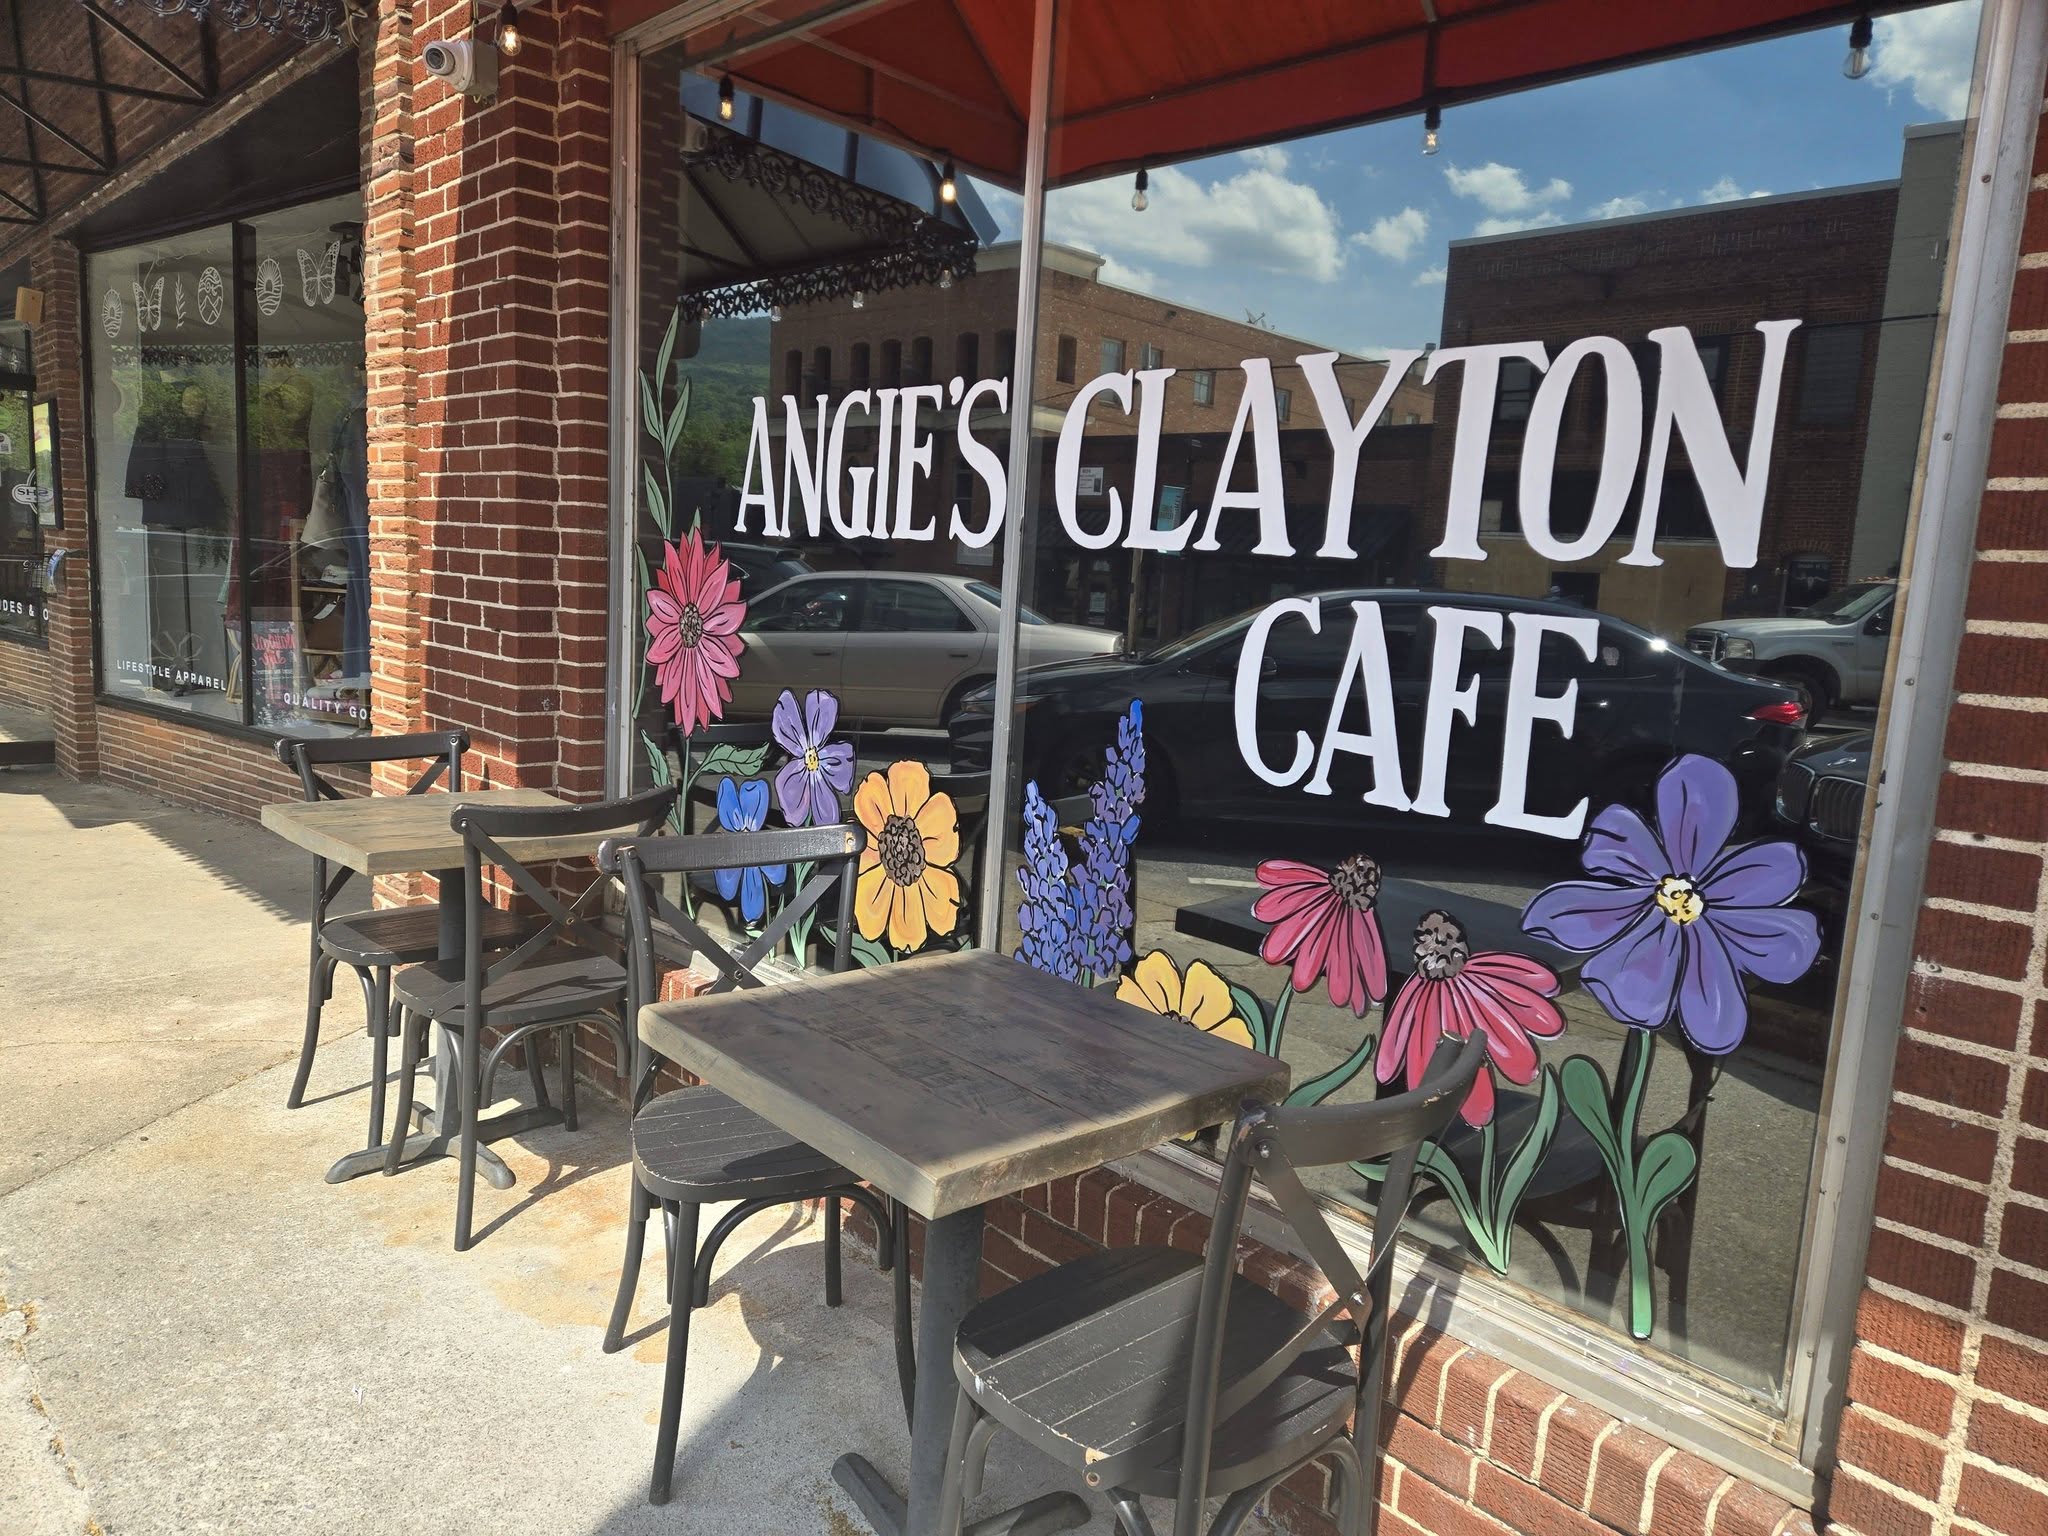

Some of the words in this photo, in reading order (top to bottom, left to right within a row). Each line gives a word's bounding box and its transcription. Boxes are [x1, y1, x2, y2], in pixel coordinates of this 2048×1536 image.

[734, 376, 1008, 548] ANGIE'S
[1055, 319, 1802, 568] CLAYTON
[0, 599, 23, 615] DES
[116, 659, 171, 679] LIFESTYLE
[175, 670, 227, 691] APPAREL
[283, 692, 341, 714] QUALITY
[349, 706, 367, 720] GO
[1234, 597, 1600, 840] CAFE
